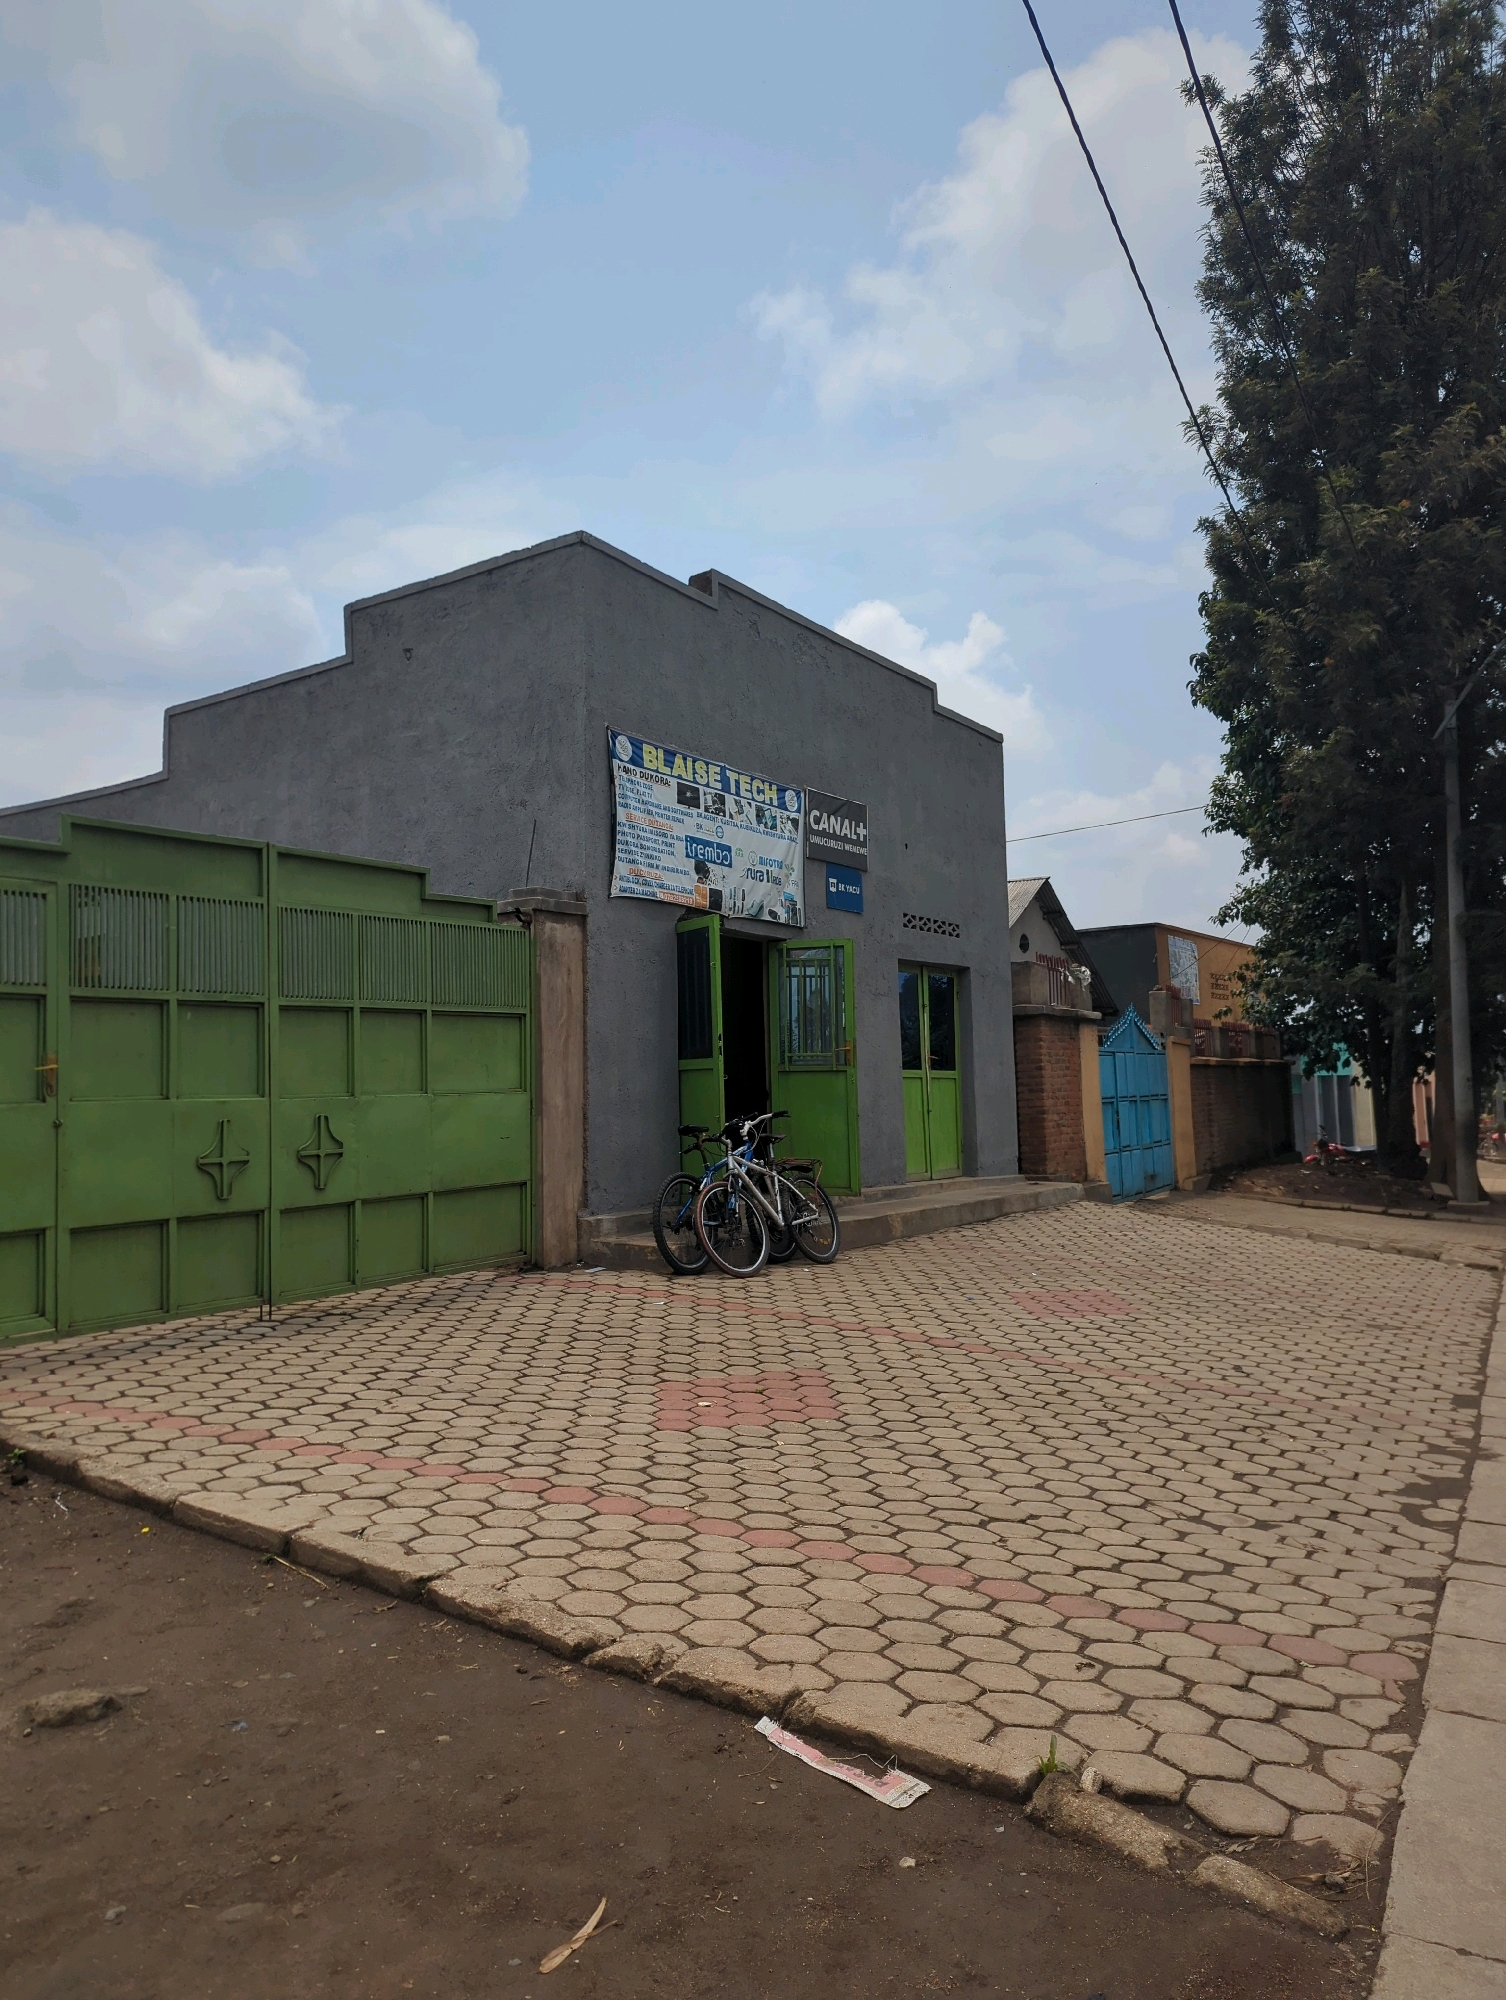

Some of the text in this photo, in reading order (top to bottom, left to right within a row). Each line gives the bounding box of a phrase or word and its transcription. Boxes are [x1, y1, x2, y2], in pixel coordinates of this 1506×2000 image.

[640, 770, 671, 787] DUKORA:
[643, 743, 778, 806] BLAISE TECH
[810, 809, 867, 842] CANAL+
[618, 830, 636, 839] PHOTO
[810, 834, 844, 850] UMUCURUZI
[838, 883, 846, 892] BK
